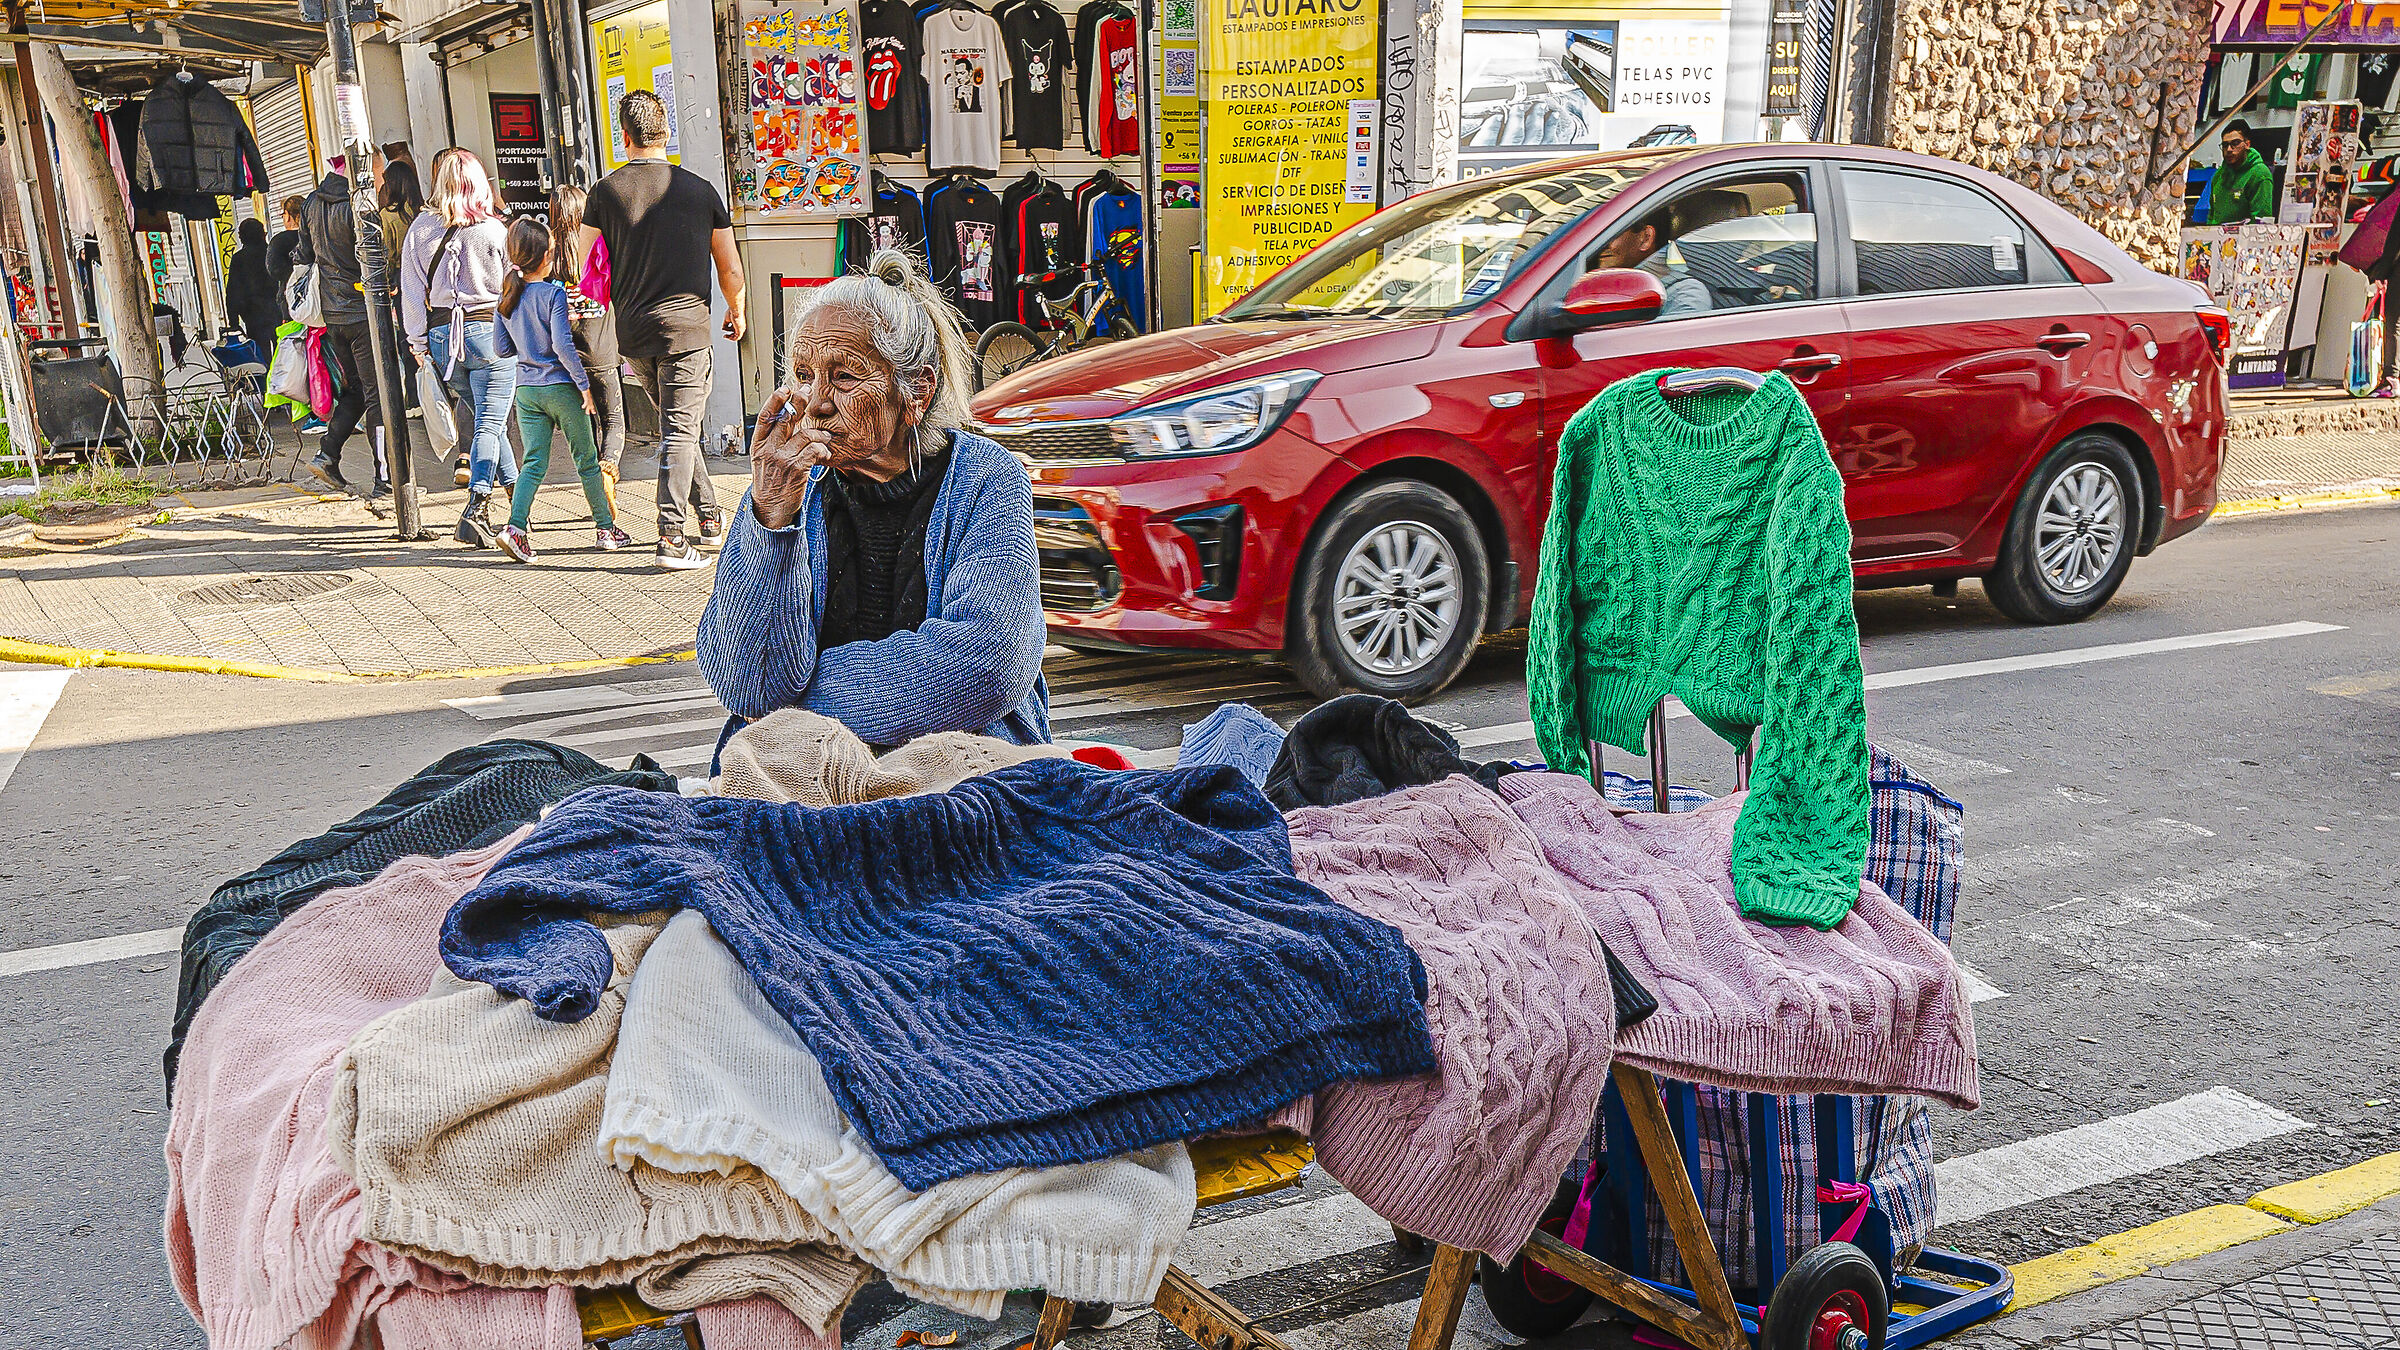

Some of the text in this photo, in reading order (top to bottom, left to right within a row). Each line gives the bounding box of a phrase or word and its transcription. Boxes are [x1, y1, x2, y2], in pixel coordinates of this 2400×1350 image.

[1223, 15, 1365, 34] ESTAMPADOS E IMPRESIONES
[1624, 36, 1715, 56] ROLLER
[1775, 41, 1799, 58] SU
[1236, 55, 1345, 76] ESTAMPADOS
[1771, 65, 1799, 75] DISEÑO
[1623, 67, 1713, 81] TELAS PVC
[1222, 77, 1365, 99] PERSONALIZADOS
[1769, 83, 1797, 97] AQUÍ
[1620, 92, 1711, 105] ADHESIVOS
[1227, 103, 1278, 115] POLERAS
[1290, 99, 1358, 114] POLERONE
[1243, 118, 1294, 131] GORROS
[1306, 116, 1341, 129] TAZAS
[1232, 135, 1299, 148] SERIGRAFIA
[496, 147, 547, 155] PORTADORA
[1218, 148, 1298, 164] SUBLIMACIÓN
[1282, 167, 1302, 178] DTF
[1222, 180, 1347, 199] SERVICIO DE DISEÑ
[506, 202, 550, 210] ATRONATO
[1241, 202, 1341, 216] IMPRESIONES Y
[1253, 221, 1333, 235] PUBLICIDAD
[1264, 239, 1318, 250] TELA PVC
[1227, 255, 1292, 267] ADHESIVOS
[1223, 285, 1254, 293] VENTAS
[2237, 360, 2278, 374] LANYARDS
